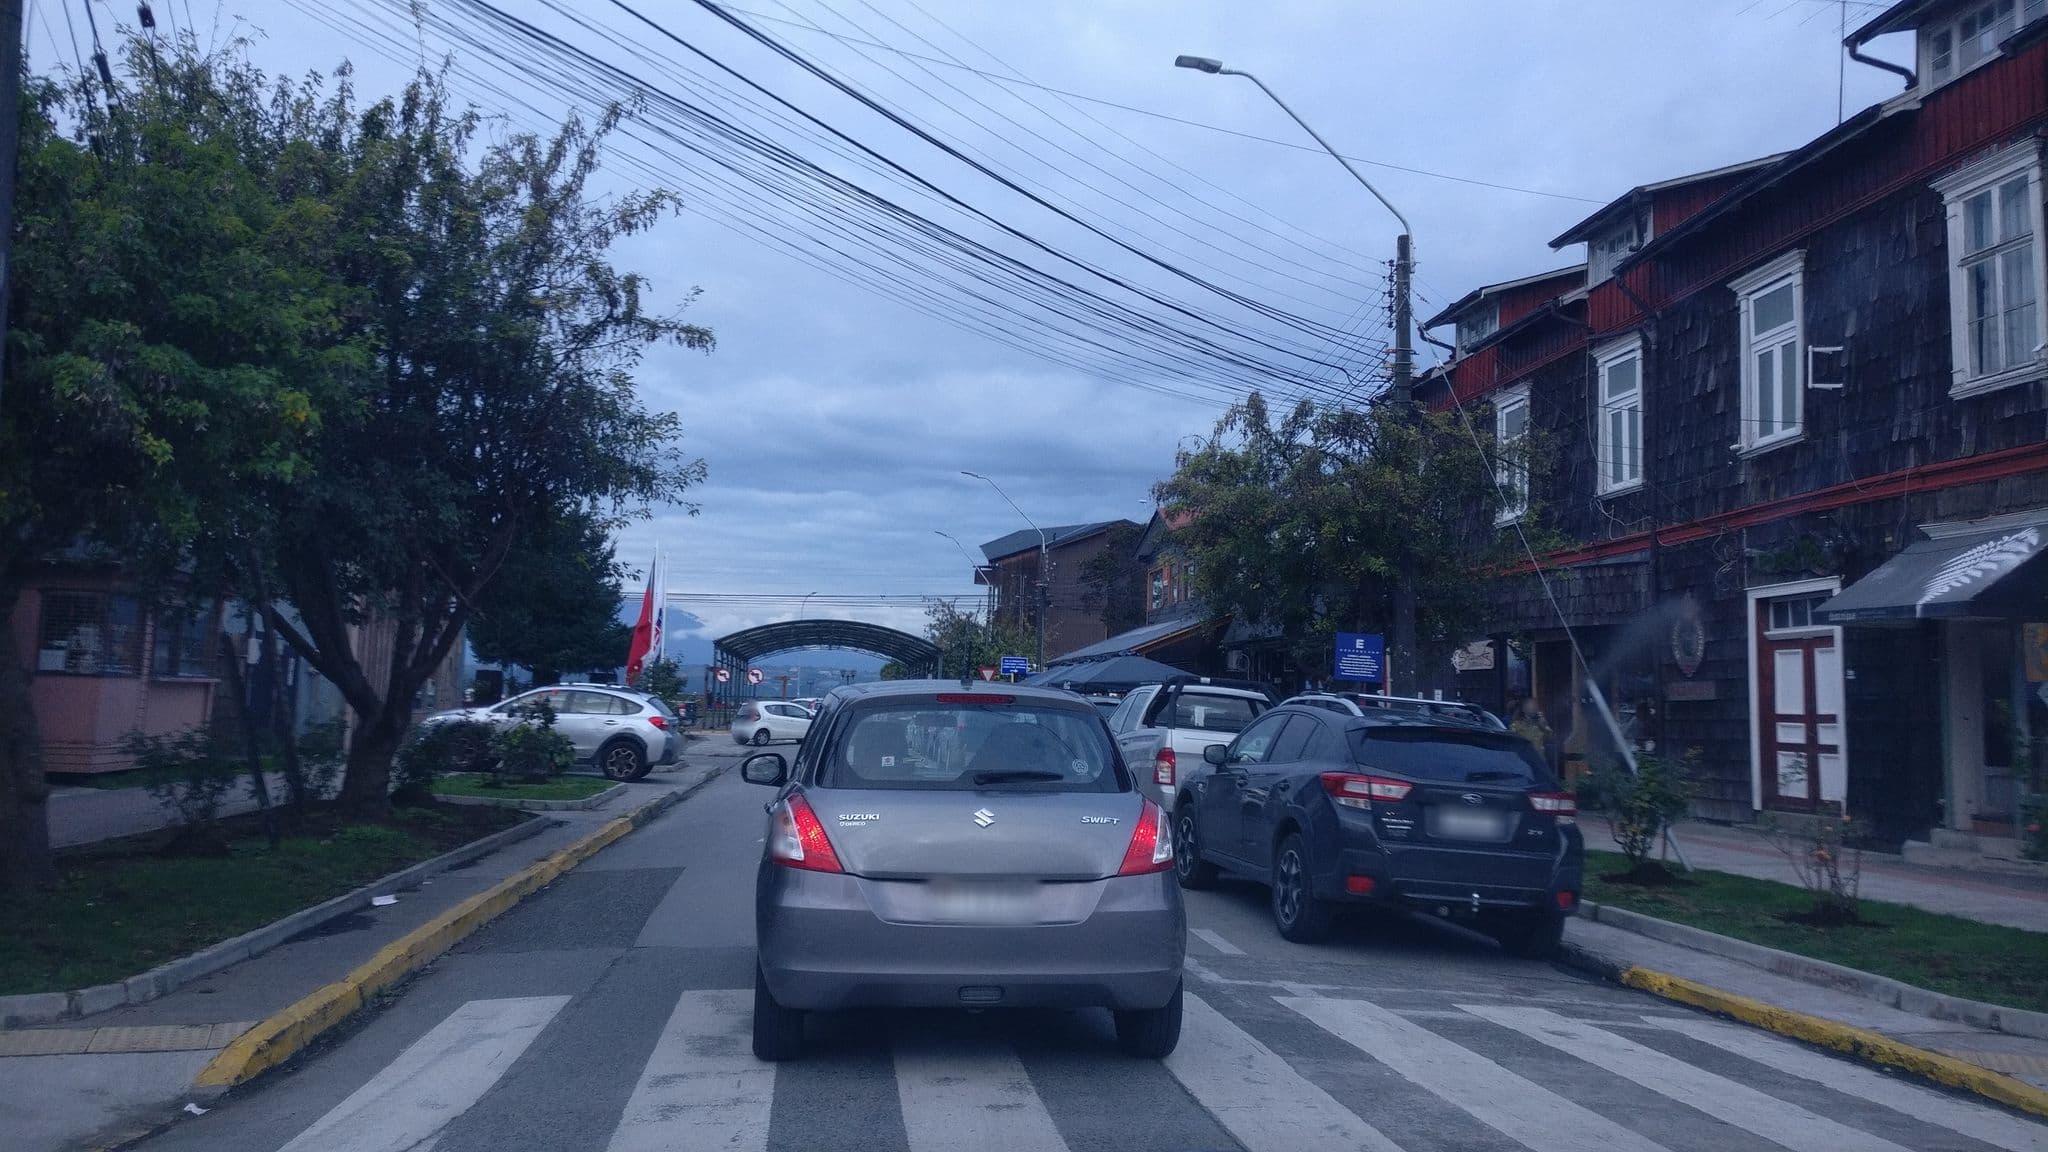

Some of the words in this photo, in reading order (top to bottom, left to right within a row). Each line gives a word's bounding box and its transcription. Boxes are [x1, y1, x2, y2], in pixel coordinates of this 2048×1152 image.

[1356, 638, 1365, 648] E
[838, 813, 880, 821] SUZUKI
[1081, 815, 1121, 824] SWIFT
